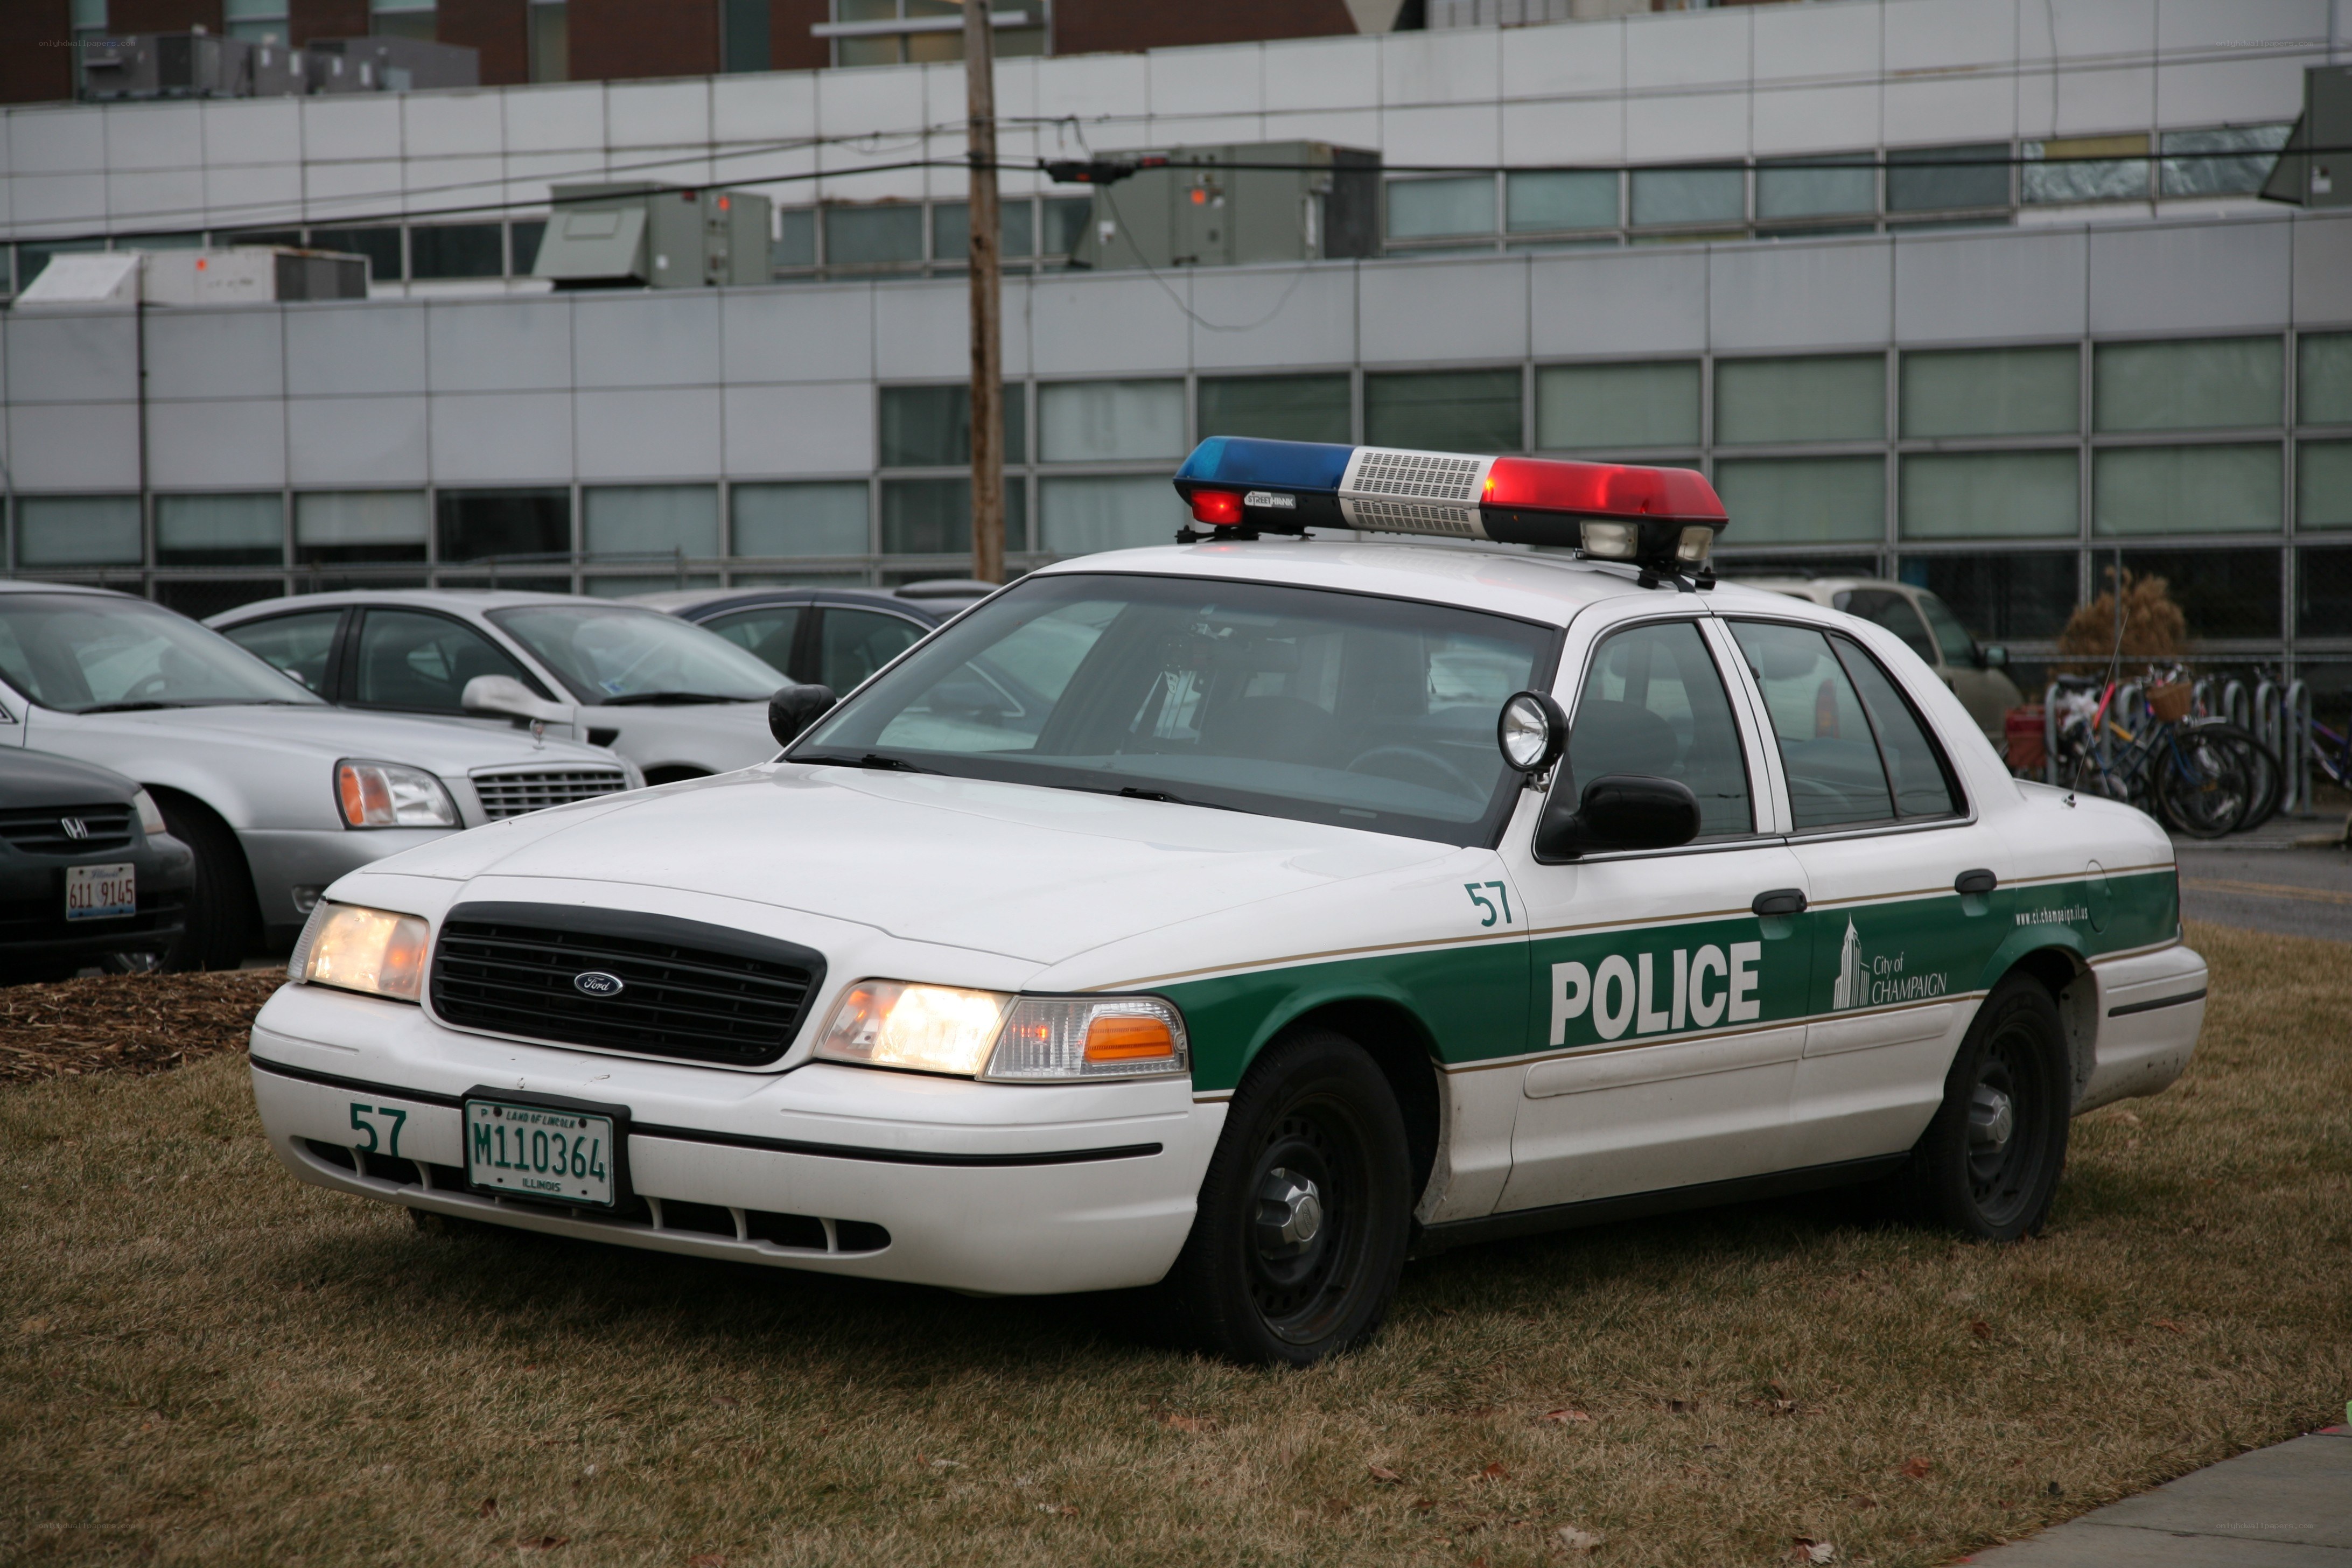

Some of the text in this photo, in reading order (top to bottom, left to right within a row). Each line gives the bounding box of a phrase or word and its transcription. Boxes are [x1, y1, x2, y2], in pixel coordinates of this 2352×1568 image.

[69, 879, 133, 909] 611 9145
[1464, 880, 1513, 927] 57
[1874, 951, 1904, 979] City of
[584, 976, 611, 991] Ford
[1549, 941, 1761, 1046] POLICE
[1872, 972, 1947, 1004] CHAMPAIGN
[350, 1102, 407, 1157] 57
[506, 1111, 576, 1129] LAND OF LINCOLN
[473, 1122, 605, 1184] M110364
[522, 1177, 561, 1192] ILLINOIS
